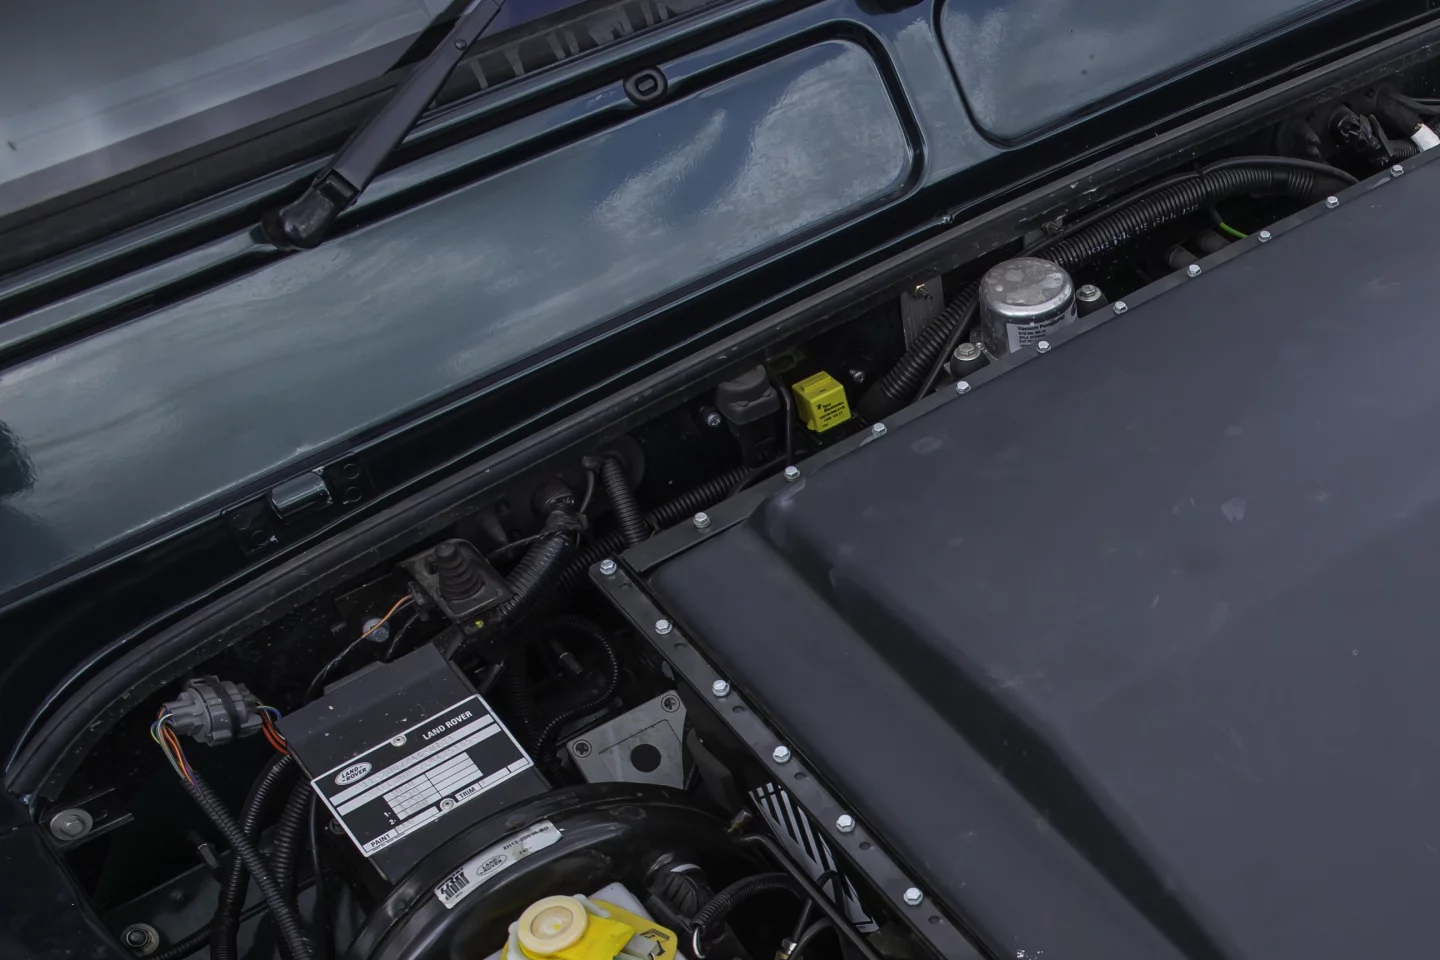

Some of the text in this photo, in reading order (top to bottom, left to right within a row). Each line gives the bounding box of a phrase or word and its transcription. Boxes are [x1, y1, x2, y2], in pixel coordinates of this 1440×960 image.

[422, 710, 473, 740] LAND ROVER
[341, 766, 359, 779] LAND
[345, 767, 367, 782] ROVER
[459, 787, 476, 799] TRIM
[370, 833, 390, 848] PAINT
[482, 858, 497, 869] LAND
[483, 860, 502, 873] ROVER
